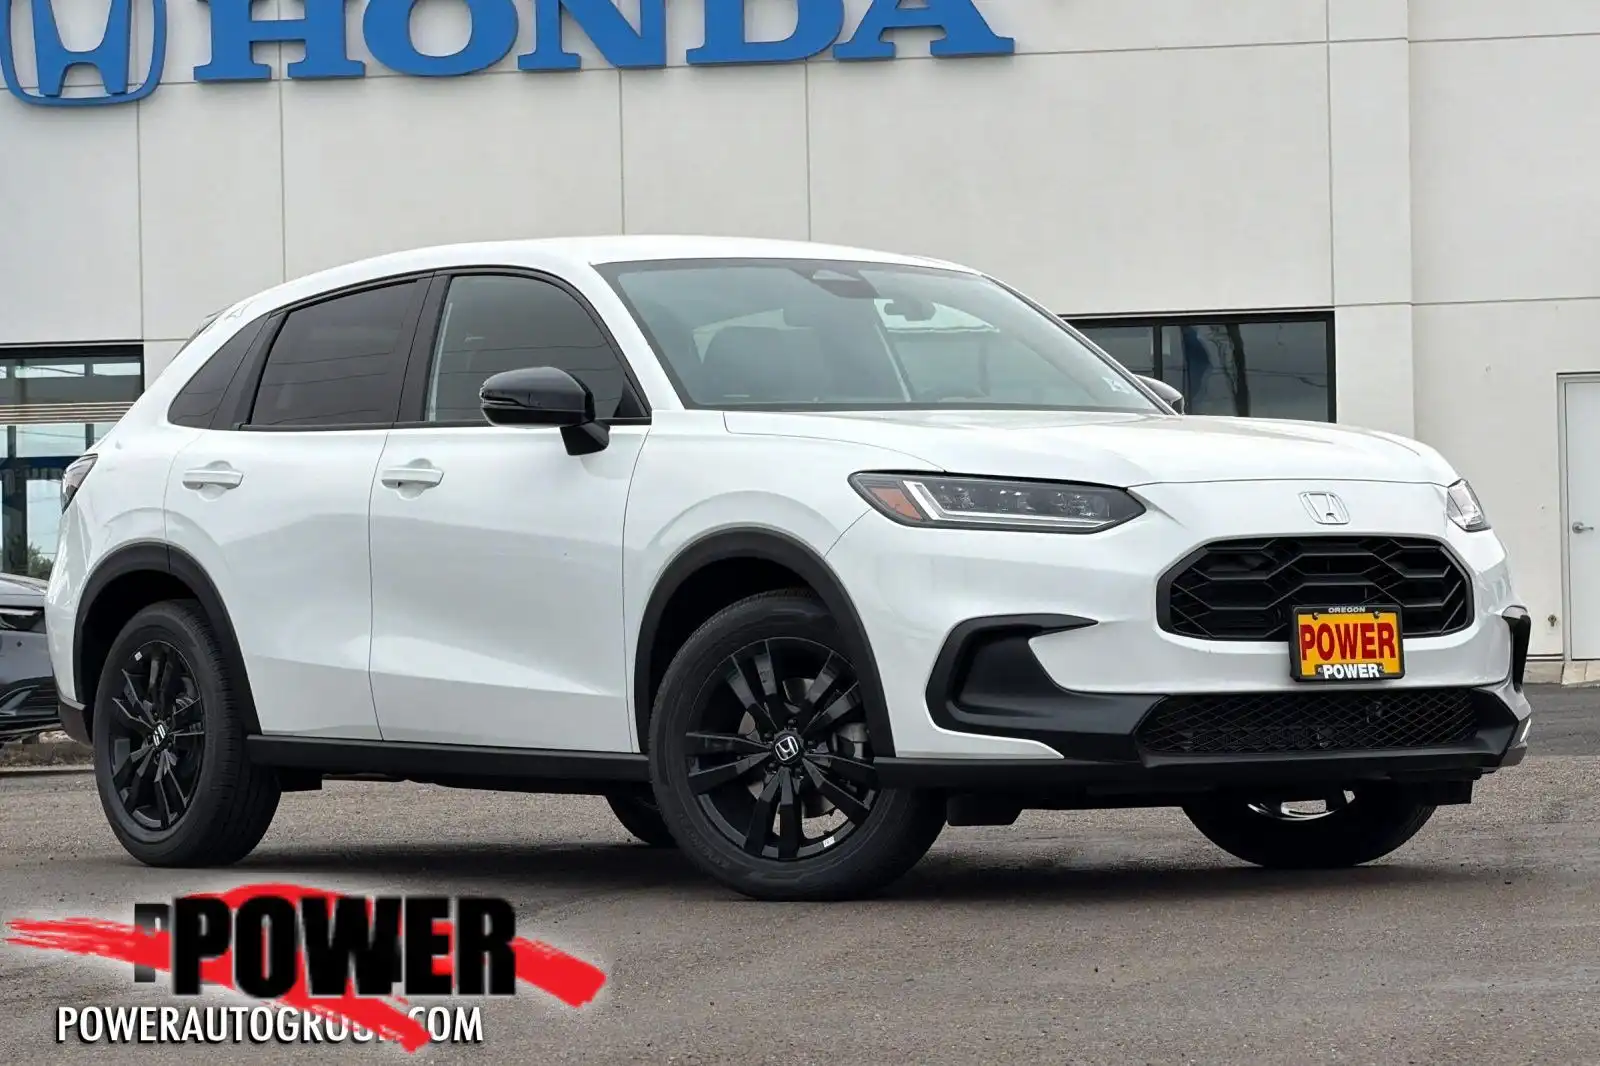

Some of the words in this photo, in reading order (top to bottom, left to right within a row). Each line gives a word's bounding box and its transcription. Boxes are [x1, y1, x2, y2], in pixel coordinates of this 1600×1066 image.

[194, 0, 1015, 81] HONDA
[1300, 622, 1396, 661] POWER
[1322, 663, 1380, 679] POWER
